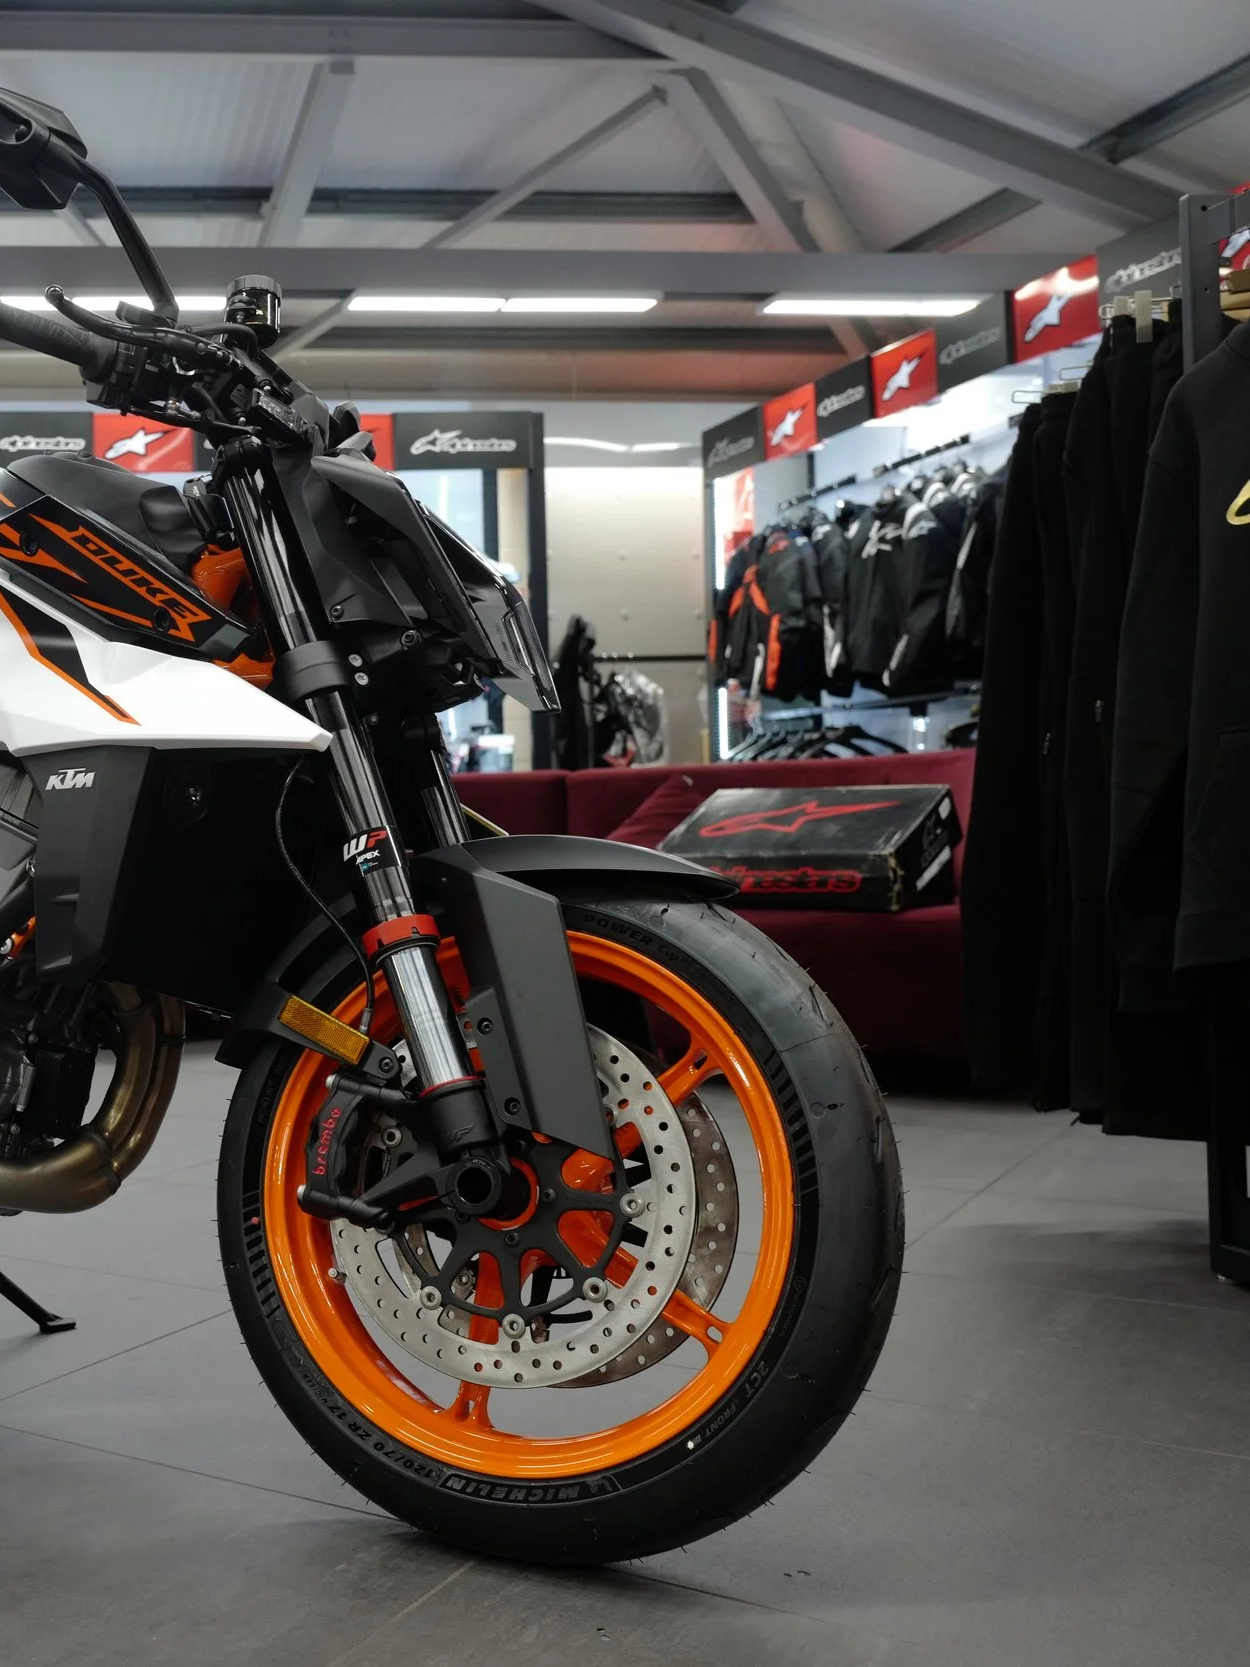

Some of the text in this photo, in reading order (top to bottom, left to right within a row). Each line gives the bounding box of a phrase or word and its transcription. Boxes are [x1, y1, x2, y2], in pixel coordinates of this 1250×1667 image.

[68, 532, 200, 621] DUKE
[45, 767, 96, 791] KTM
[343, 829, 388, 862] WP
[583, 913, 654, 946] POWER
[312, 1107, 342, 1175] brembo
[328, 1404, 348, 1421] 17
[702, 1360, 770, 1439] 2CT FRONT
[347, 1421, 373, 1441] ZR
[372, 1441, 434, 1479] 120/70
[445, 1475, 580, 1502] MICHELIN
